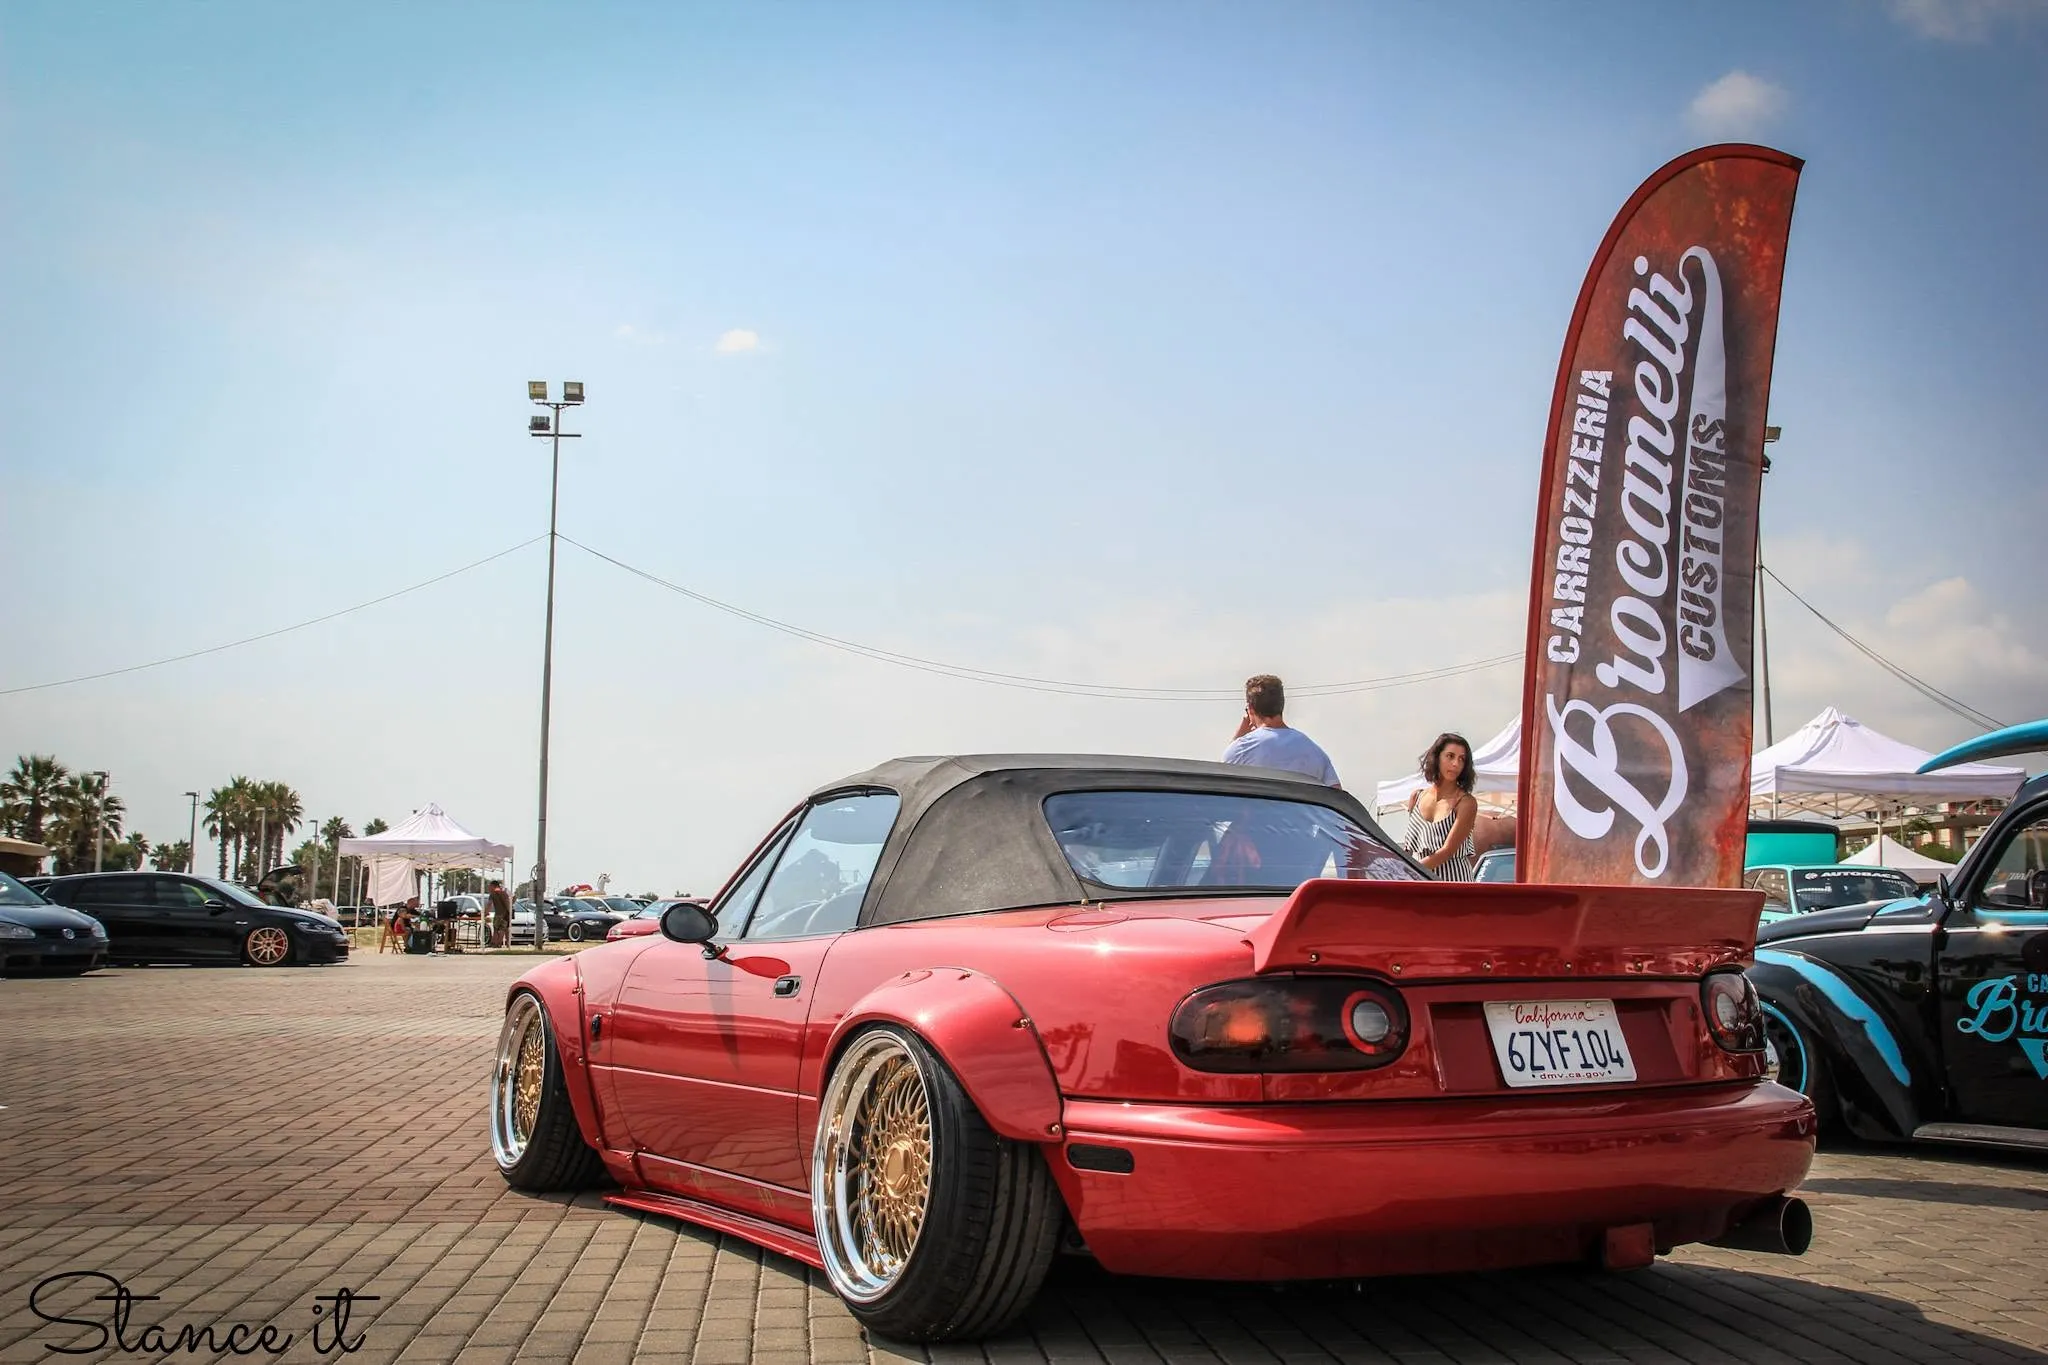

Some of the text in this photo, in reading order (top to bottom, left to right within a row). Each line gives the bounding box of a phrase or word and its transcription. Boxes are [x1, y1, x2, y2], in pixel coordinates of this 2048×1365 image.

[1547, 370, 1613, 664] CARROZZERIA
[1680, 413, 1726, 662] CUSTOMS
[1546, 245, 1712, 879] Brocanelli
[1820, 871, 1901, 880] AUTOBACS
[1515, 1004, 1595, 1028] California
[1508, 1029, 1624, 1072] 6ZYF104
[1539, 1071, 1605, 1080] dmv.ca.gov
